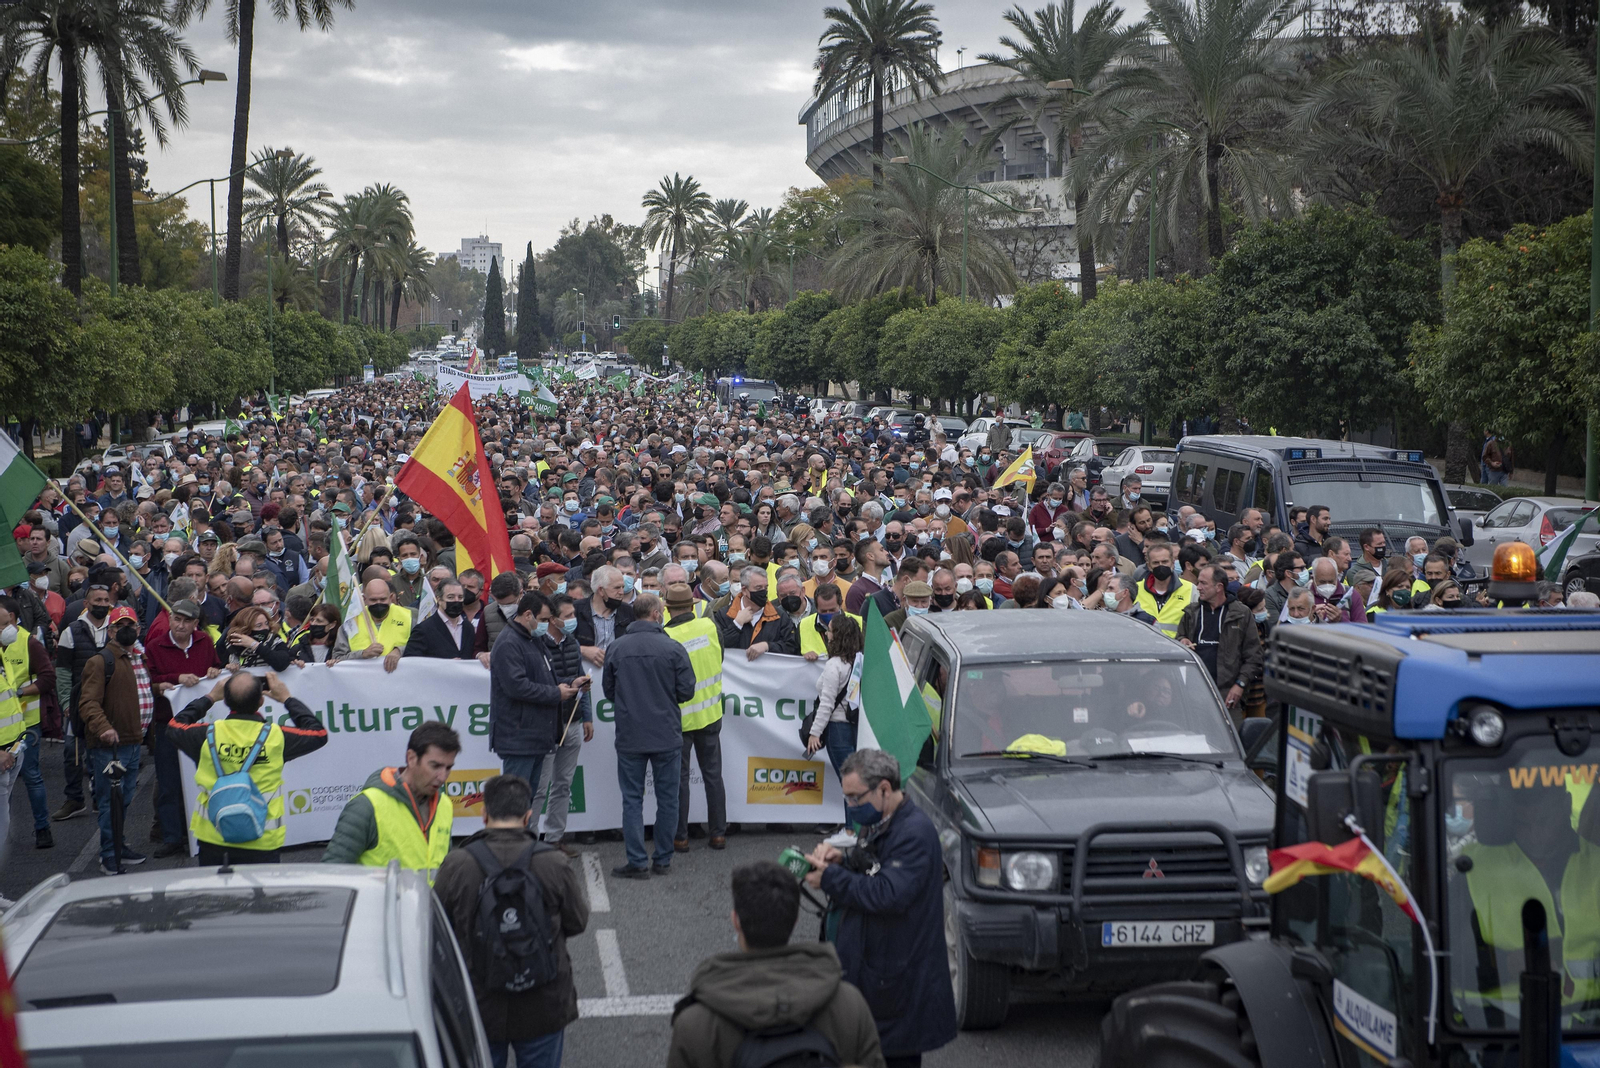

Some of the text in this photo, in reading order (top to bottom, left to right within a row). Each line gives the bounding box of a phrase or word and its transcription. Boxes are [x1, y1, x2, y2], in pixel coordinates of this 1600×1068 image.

[534, 402, 552, 414] AMPO
[755, 768, 815, 783] COAG
[312, 784, 363, 795] cooperativa
[1117, 925, 1162, 943] 6144
[1172, 925, 1206, 943] CHZ
